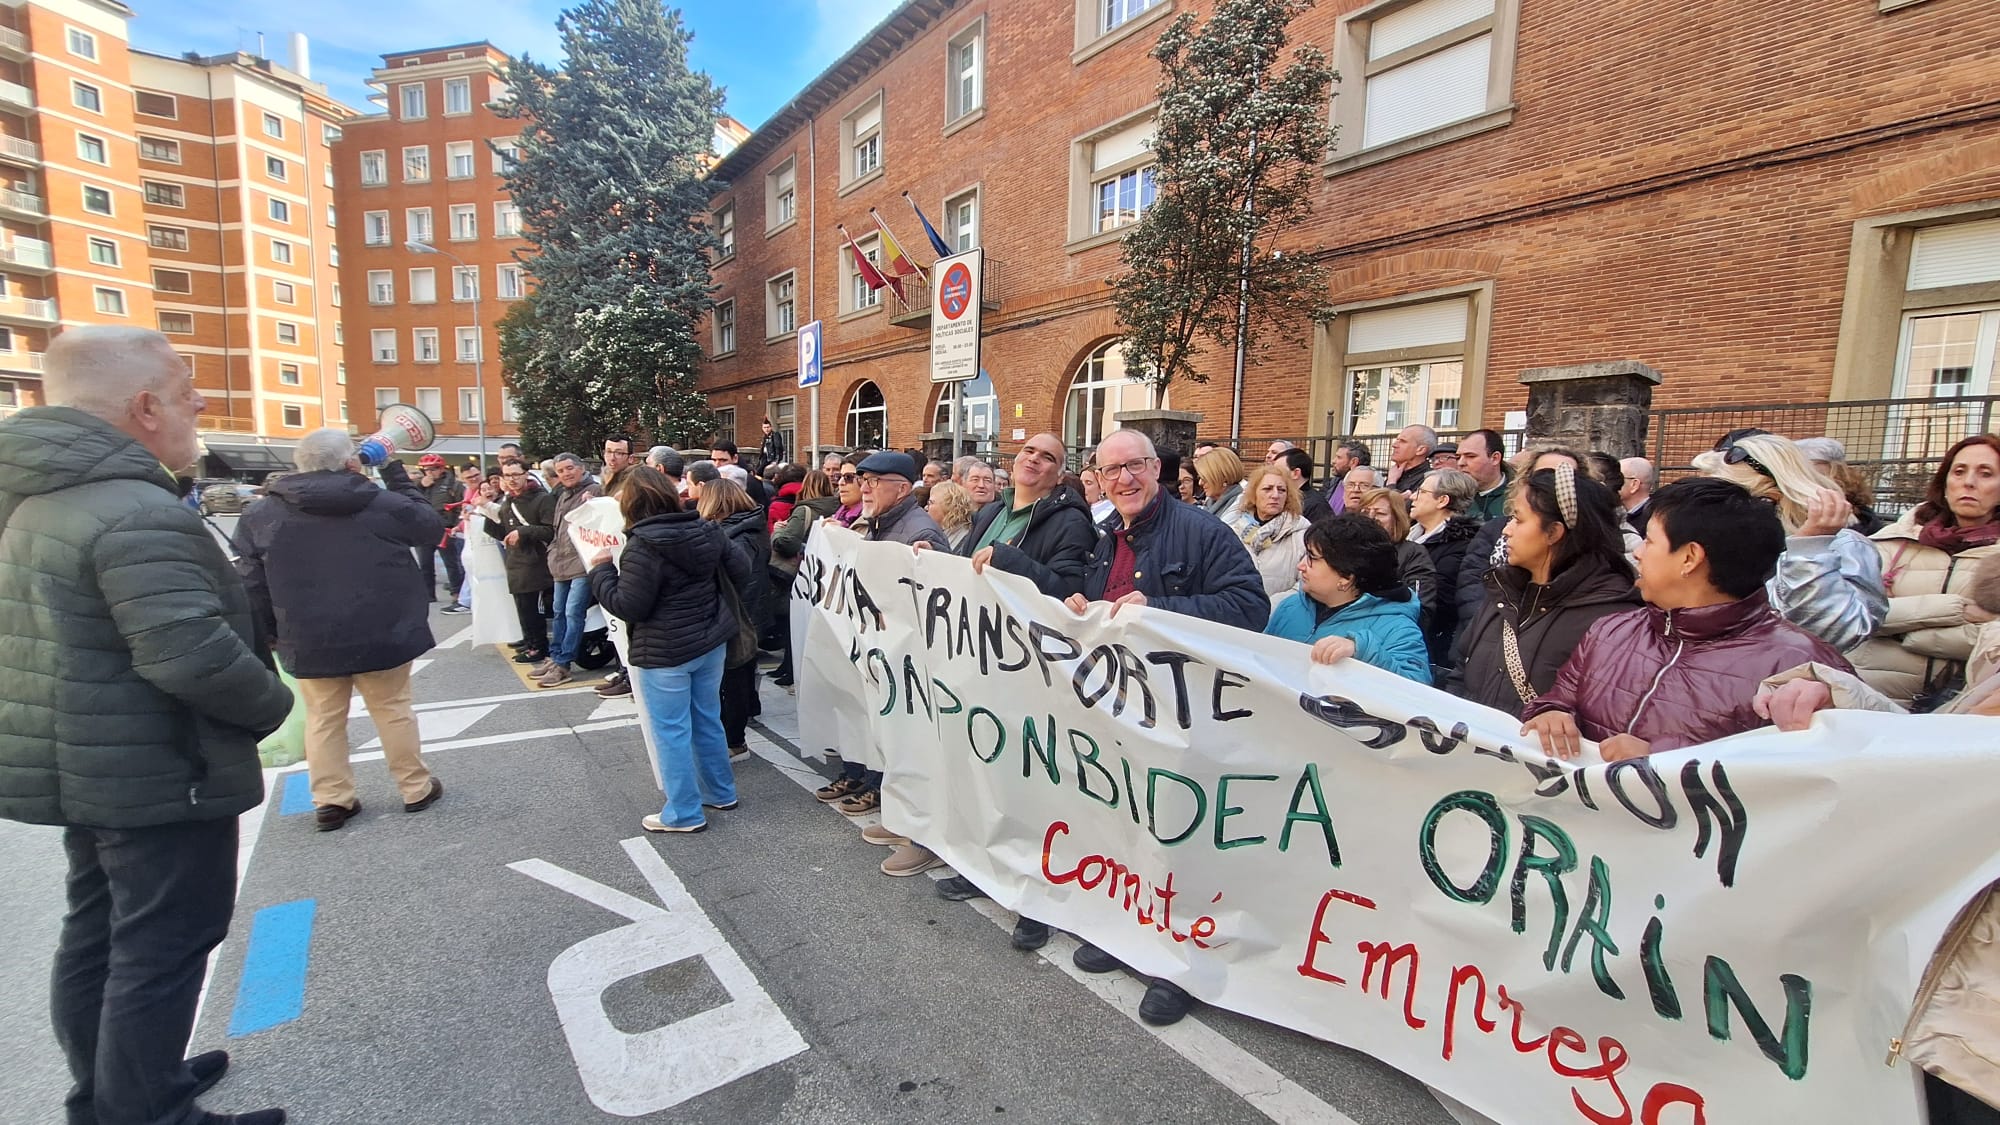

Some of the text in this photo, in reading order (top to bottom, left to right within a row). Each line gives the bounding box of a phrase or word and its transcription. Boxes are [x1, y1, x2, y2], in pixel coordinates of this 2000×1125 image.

[801, 332, 816, 385] P
[937, 320, 966, 331] DEPARTAMENTO
[954, 326, 974, 335] SOCIALES
[898, 577, 1254, 730] TRANSPORTE
[1042, 820, 1229, 949] Comité
[505, 835, 811, 1117] R
